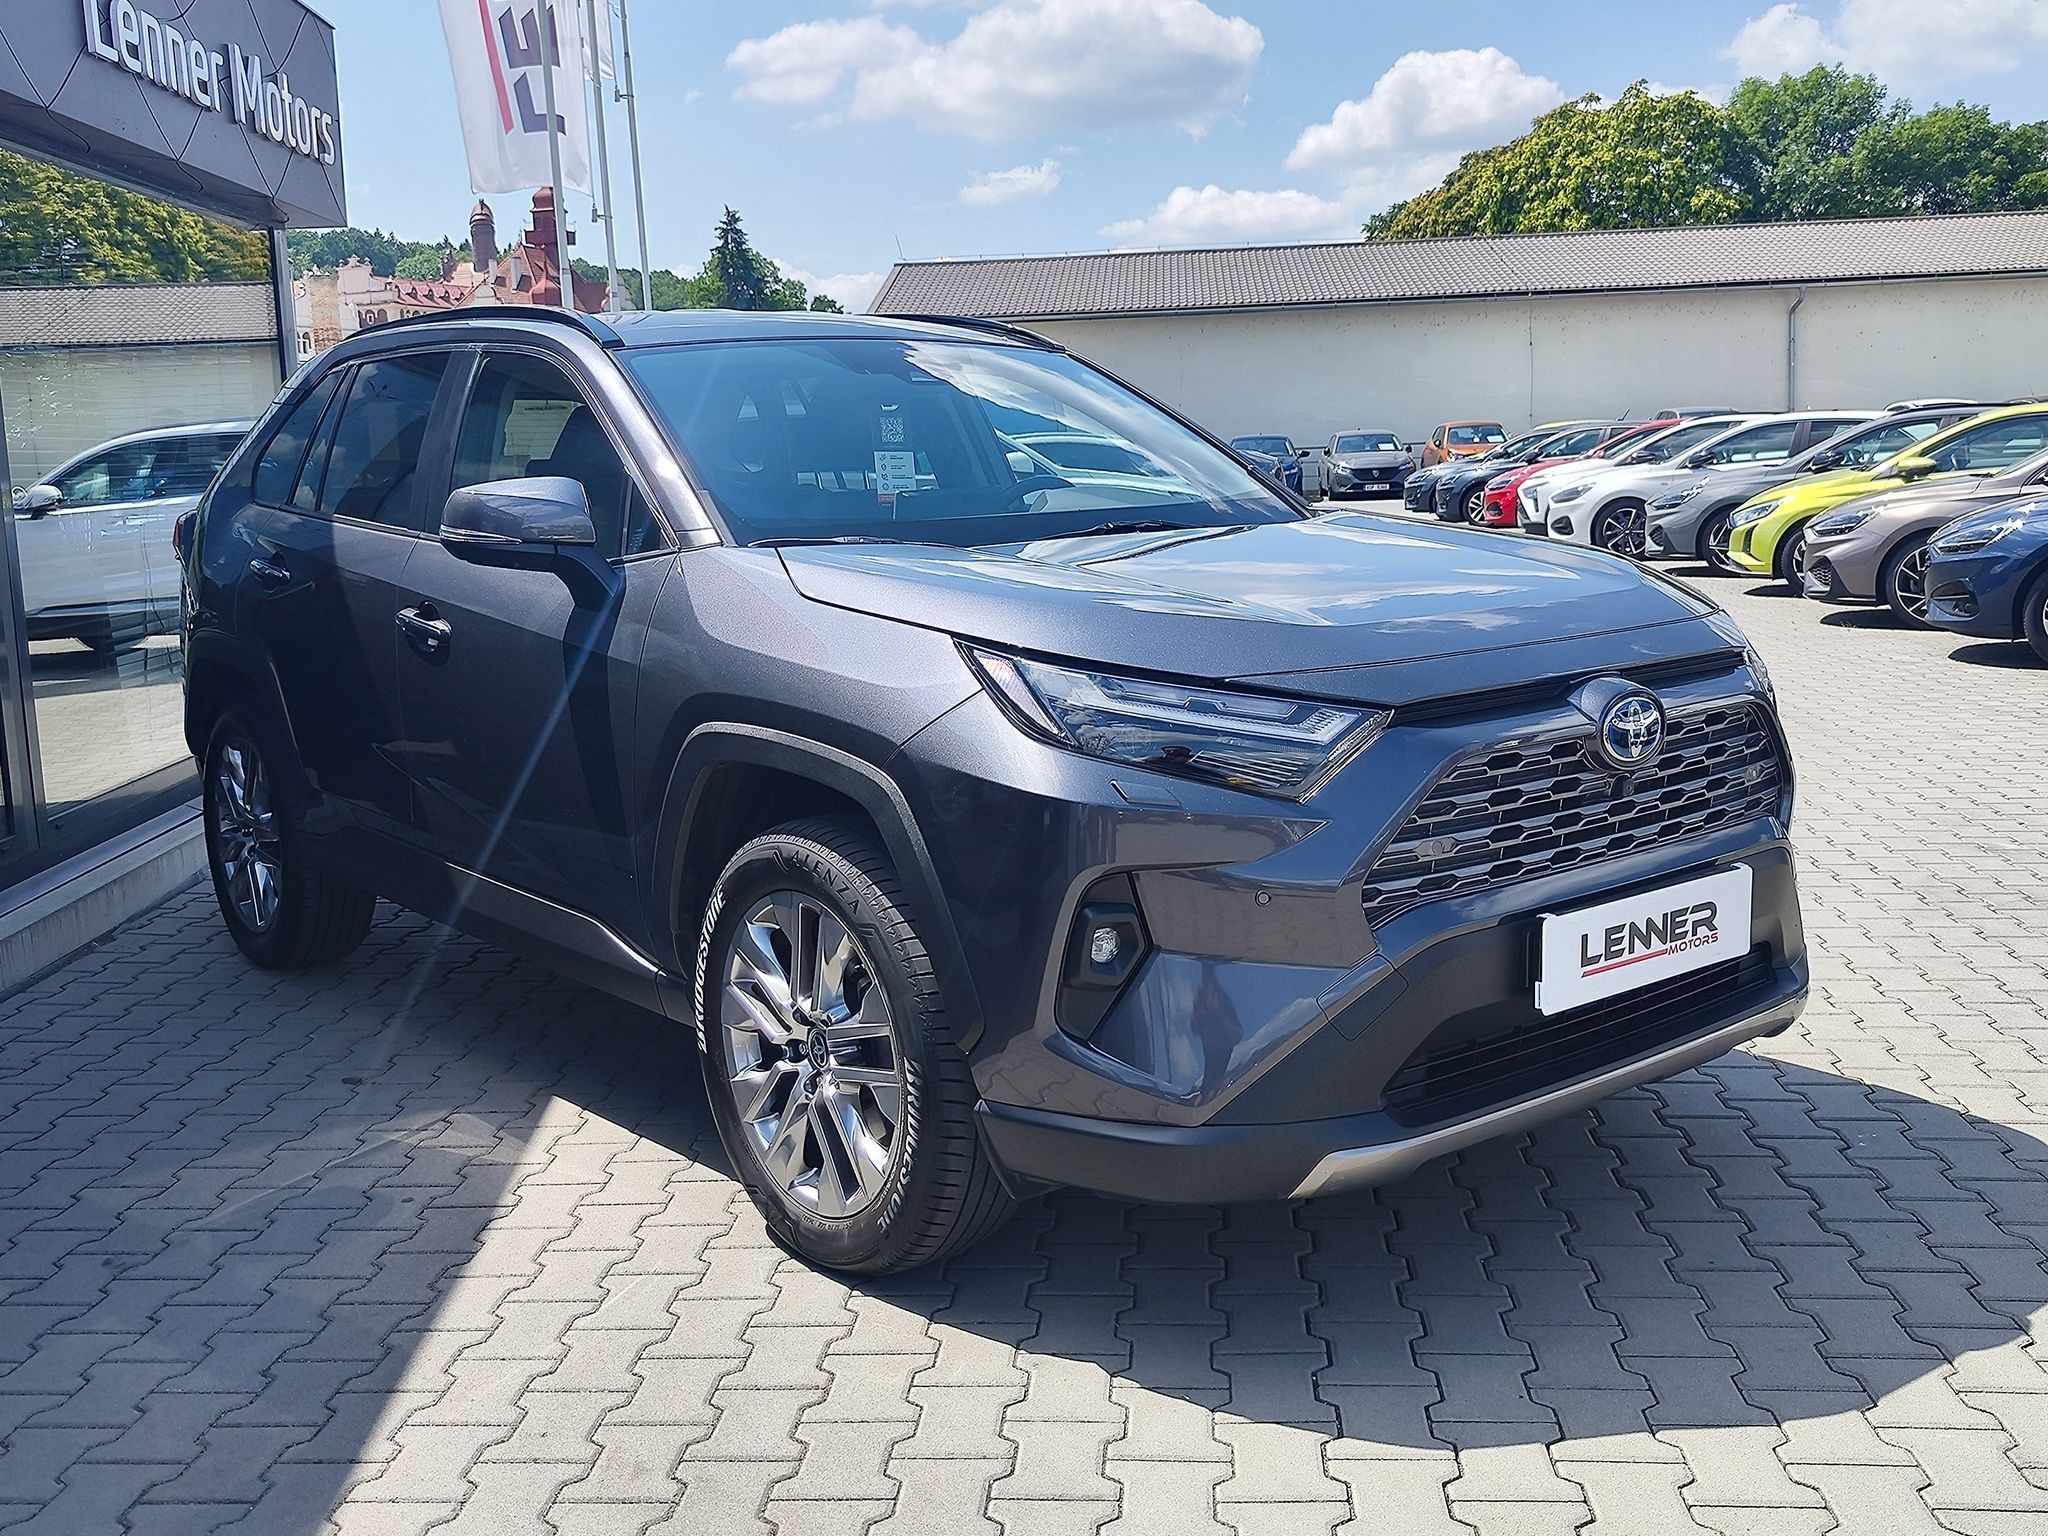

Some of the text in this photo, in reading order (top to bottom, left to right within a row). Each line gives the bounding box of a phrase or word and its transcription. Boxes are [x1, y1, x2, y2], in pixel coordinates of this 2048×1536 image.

[82, 0, 336, 166] Lenner Motors
[792, 849, 860, 916] ALENZA
[1580, 901, 1719, 969] LENNER
[1667, 932, 1719, 956] MOTORS
[694, 884, 727, 1055] BRIDGESTONE
